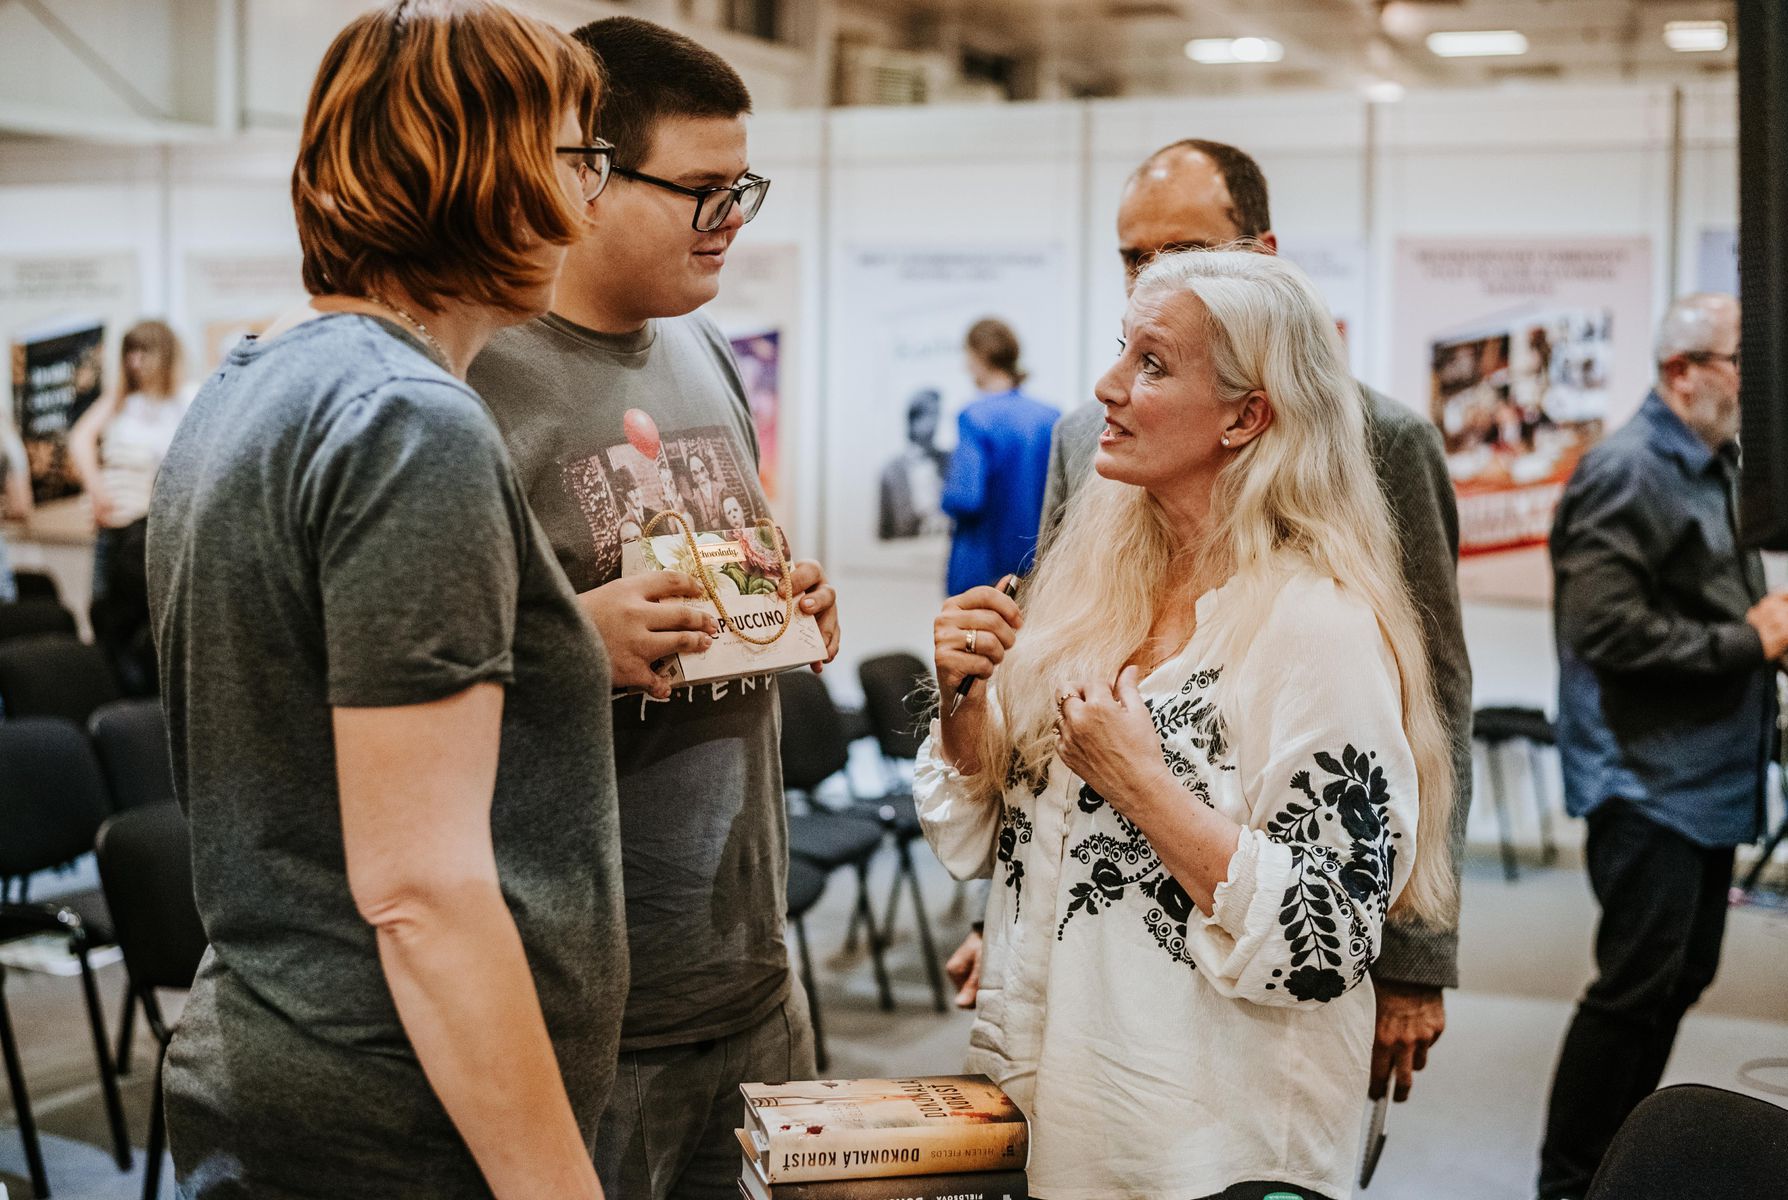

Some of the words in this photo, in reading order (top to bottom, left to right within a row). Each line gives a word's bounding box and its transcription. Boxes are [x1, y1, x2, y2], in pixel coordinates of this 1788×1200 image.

[711, 610, 785, 639] PUCCINO
[782, 1151, 836, 1171] KORISŤ
[844, 1148, 920, 1168] DOKONALÁ
[930, 1149, 961, 1159] FIELDS
[965, 1148, 994, 1159] HELEN
